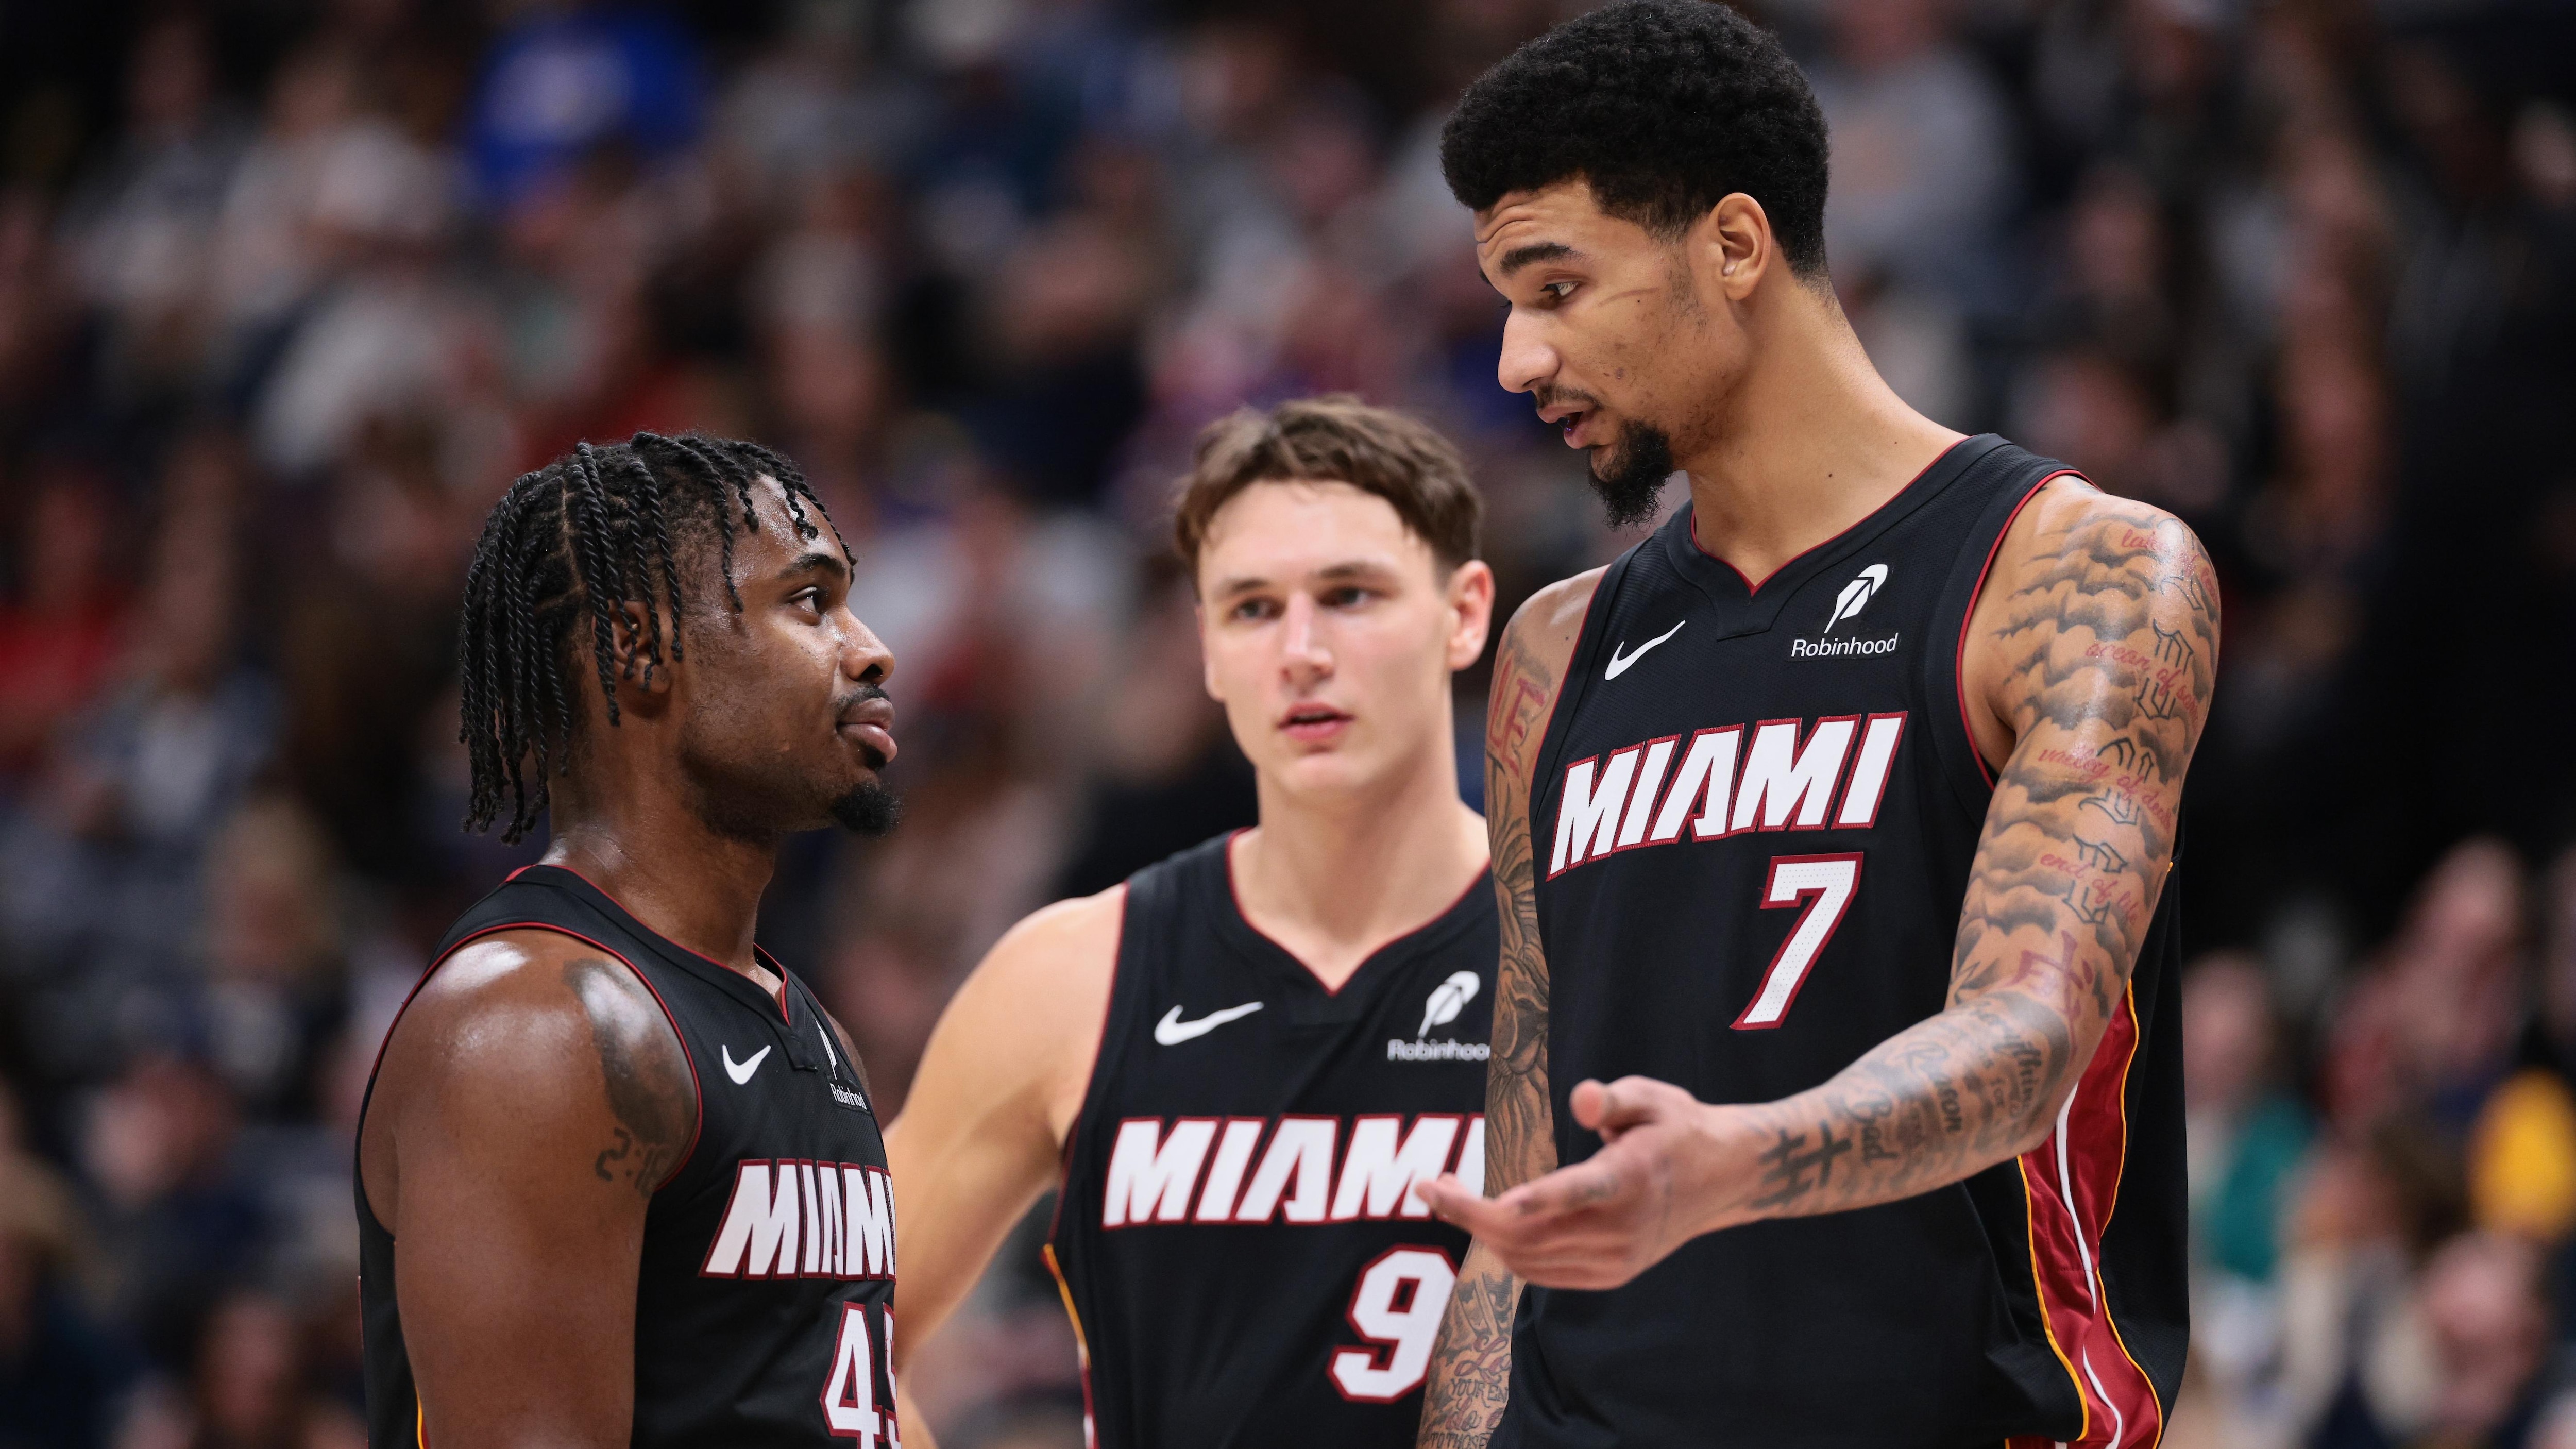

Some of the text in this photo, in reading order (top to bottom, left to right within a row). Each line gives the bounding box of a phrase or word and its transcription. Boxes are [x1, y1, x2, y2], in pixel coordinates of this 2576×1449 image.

[1791, 632, 1899, 657] Robinhood
[2156, 669, 2182, 696] of
[1546, 711, 1908, 882] MIAMI
[2116, 774, 2145, 800] of
[2040, 854, 2092, 879] end
[2092, 879, 2119, 905] of
[1729, 852, 1863, 1031] 7
[1387, 1038, 1490, 1061] Robinhoo
[698, 1158, 896, 1281] MIAM
[1325, 1242, 1459, 1405] 9
